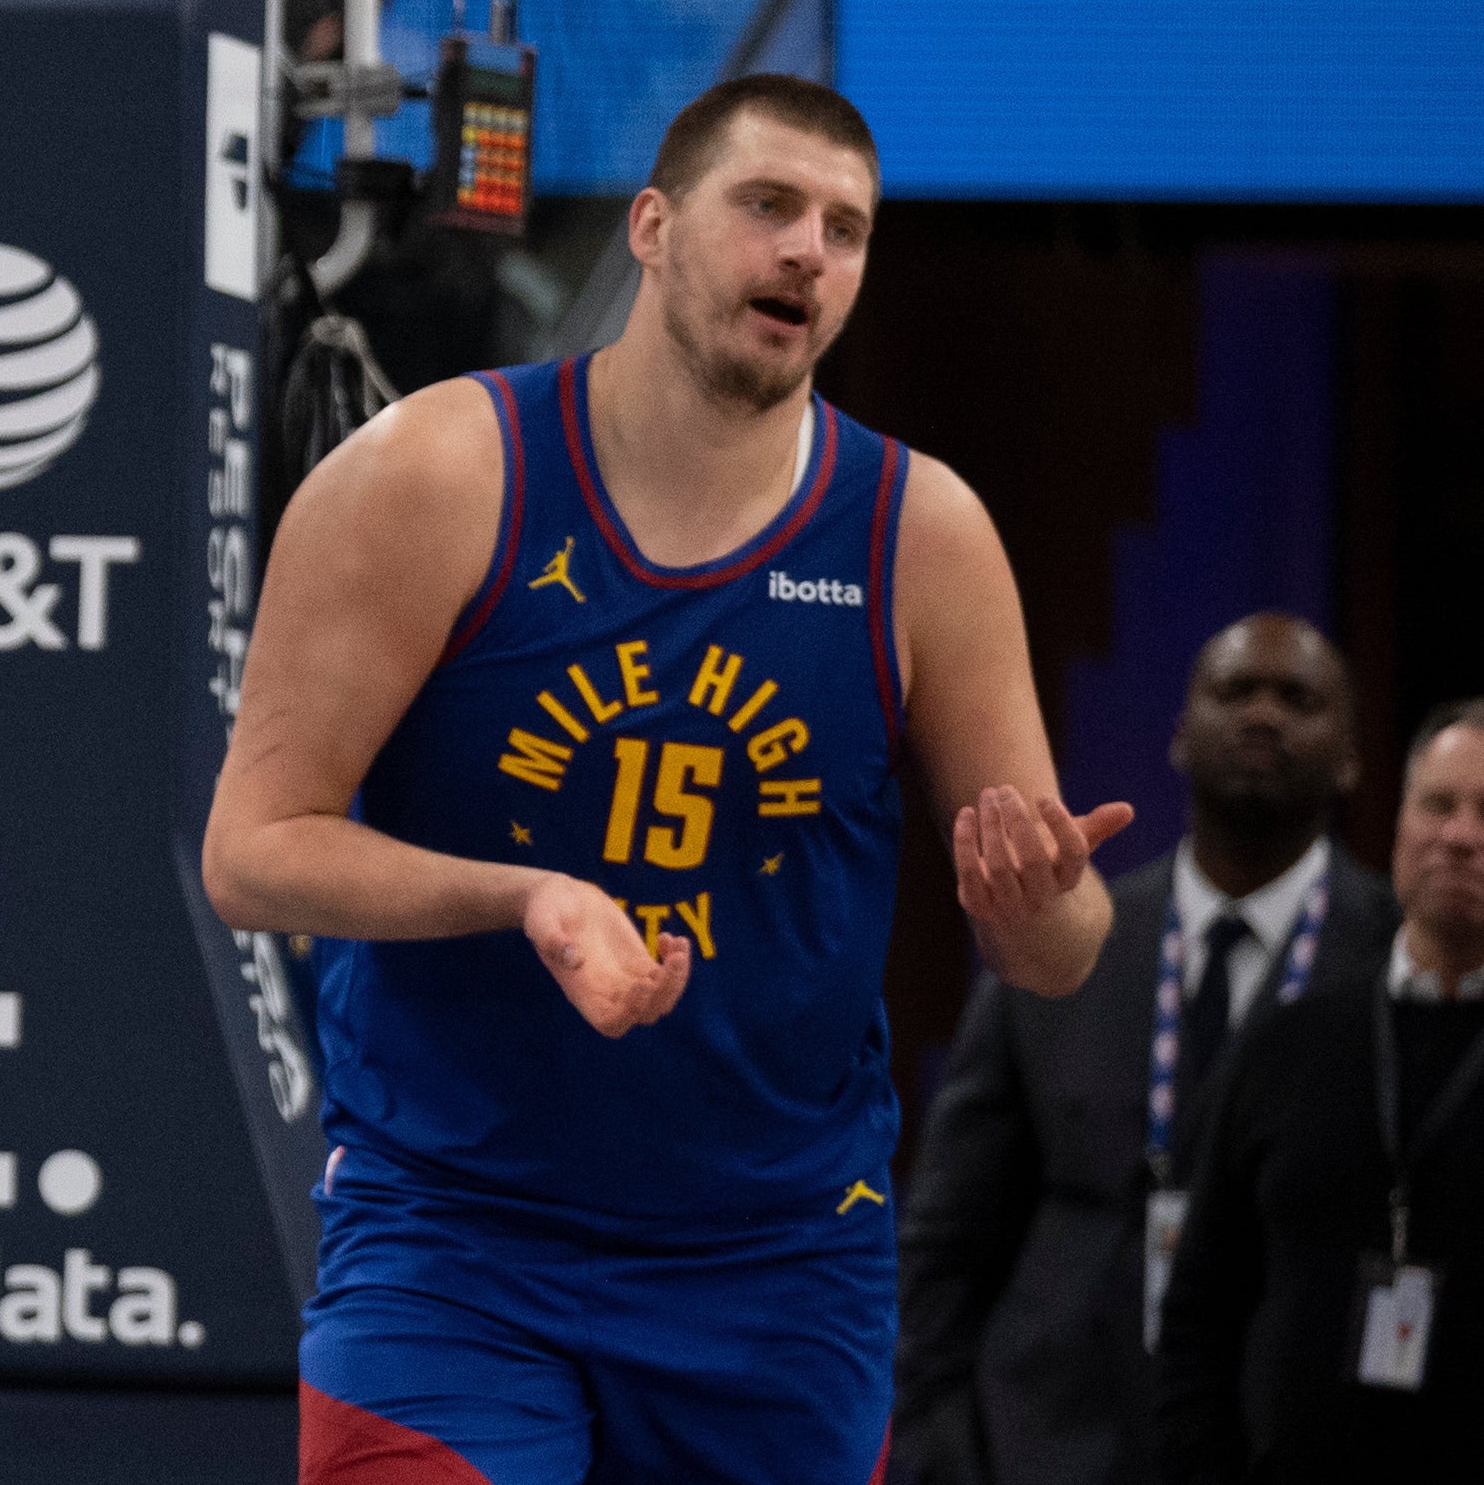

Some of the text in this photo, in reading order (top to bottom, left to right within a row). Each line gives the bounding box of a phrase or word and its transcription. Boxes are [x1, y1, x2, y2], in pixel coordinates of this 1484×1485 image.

[768, 570, 863, 607] ibotta
[497, 640, 823, 817] MILE HIGH
[602, 736, 726, 871] 15
